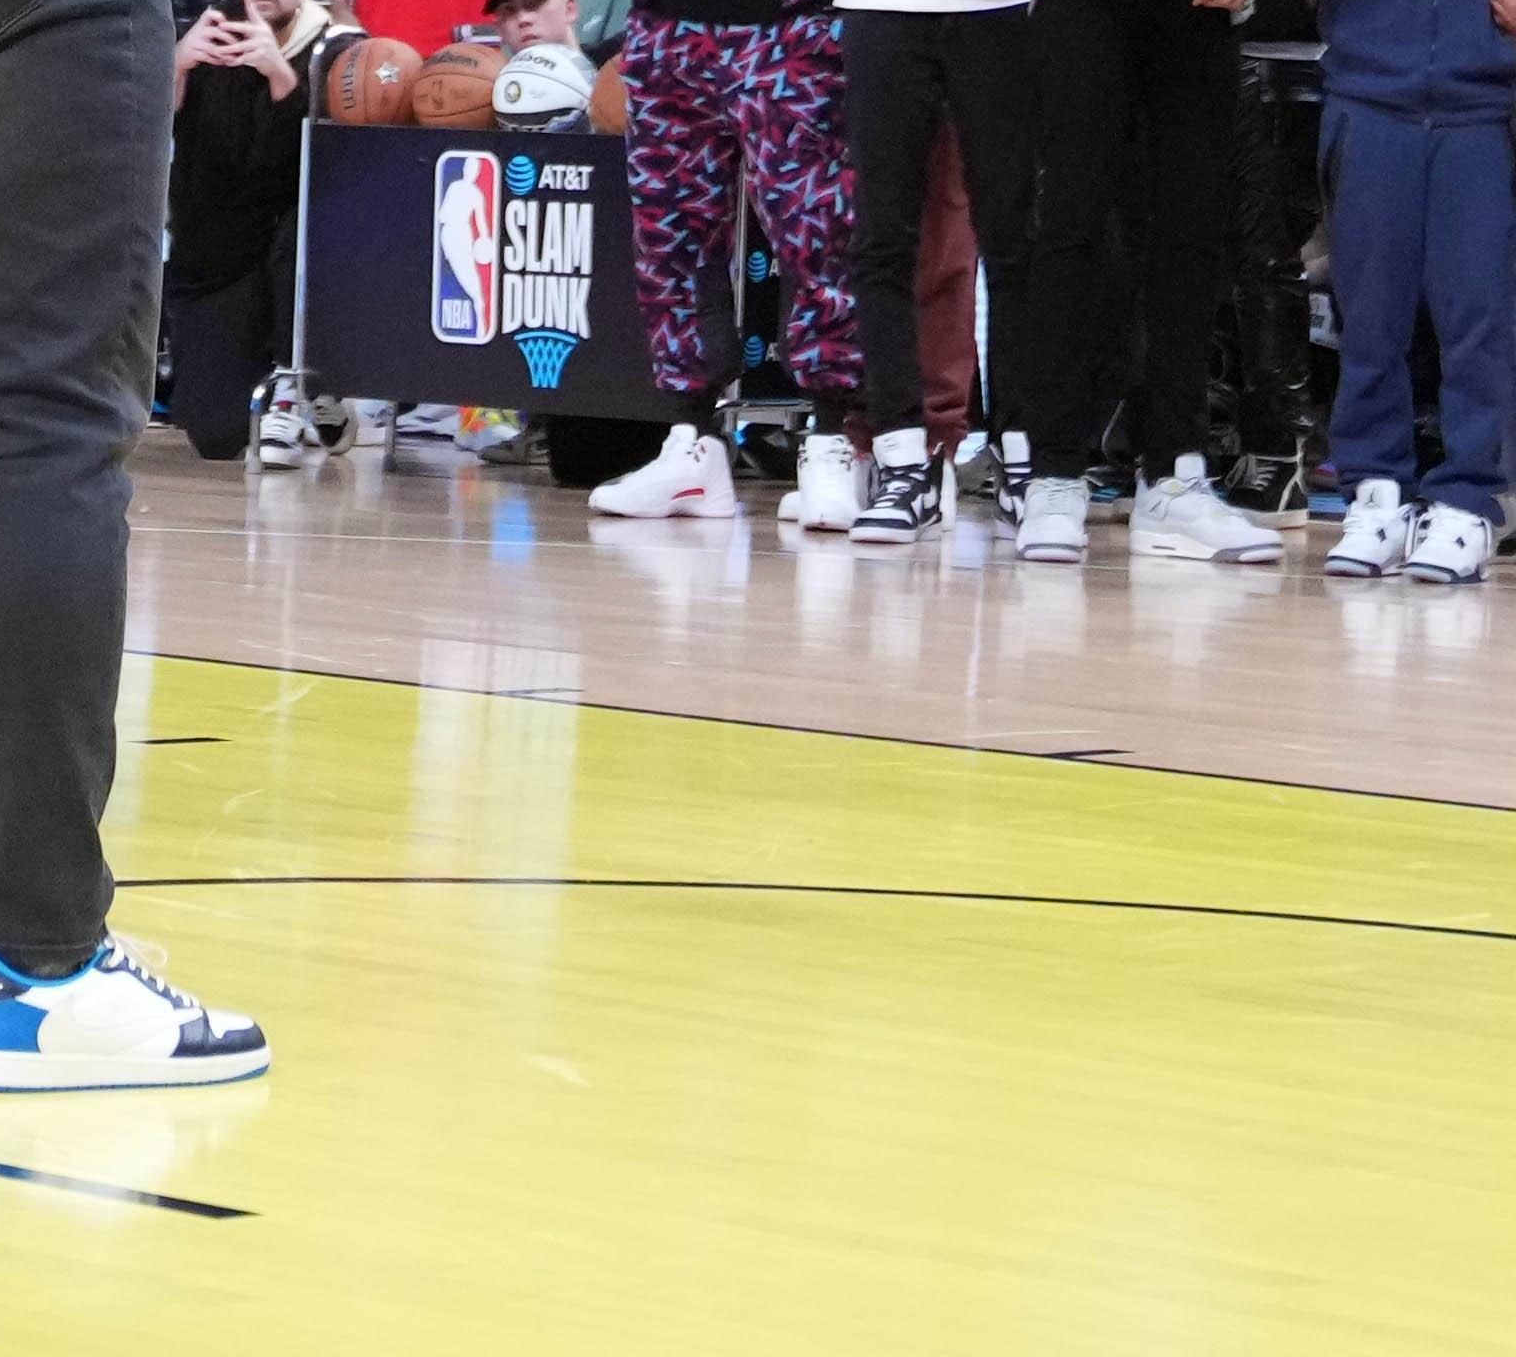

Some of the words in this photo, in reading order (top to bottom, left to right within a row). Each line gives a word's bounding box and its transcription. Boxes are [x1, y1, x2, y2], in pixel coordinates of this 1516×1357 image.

[537, 164, 594, 190] AT&T
[503, 199, 594, 274] SLAM
[441, 297, 473, 330] NBA
[501, 274, 592, 339] DUNK
